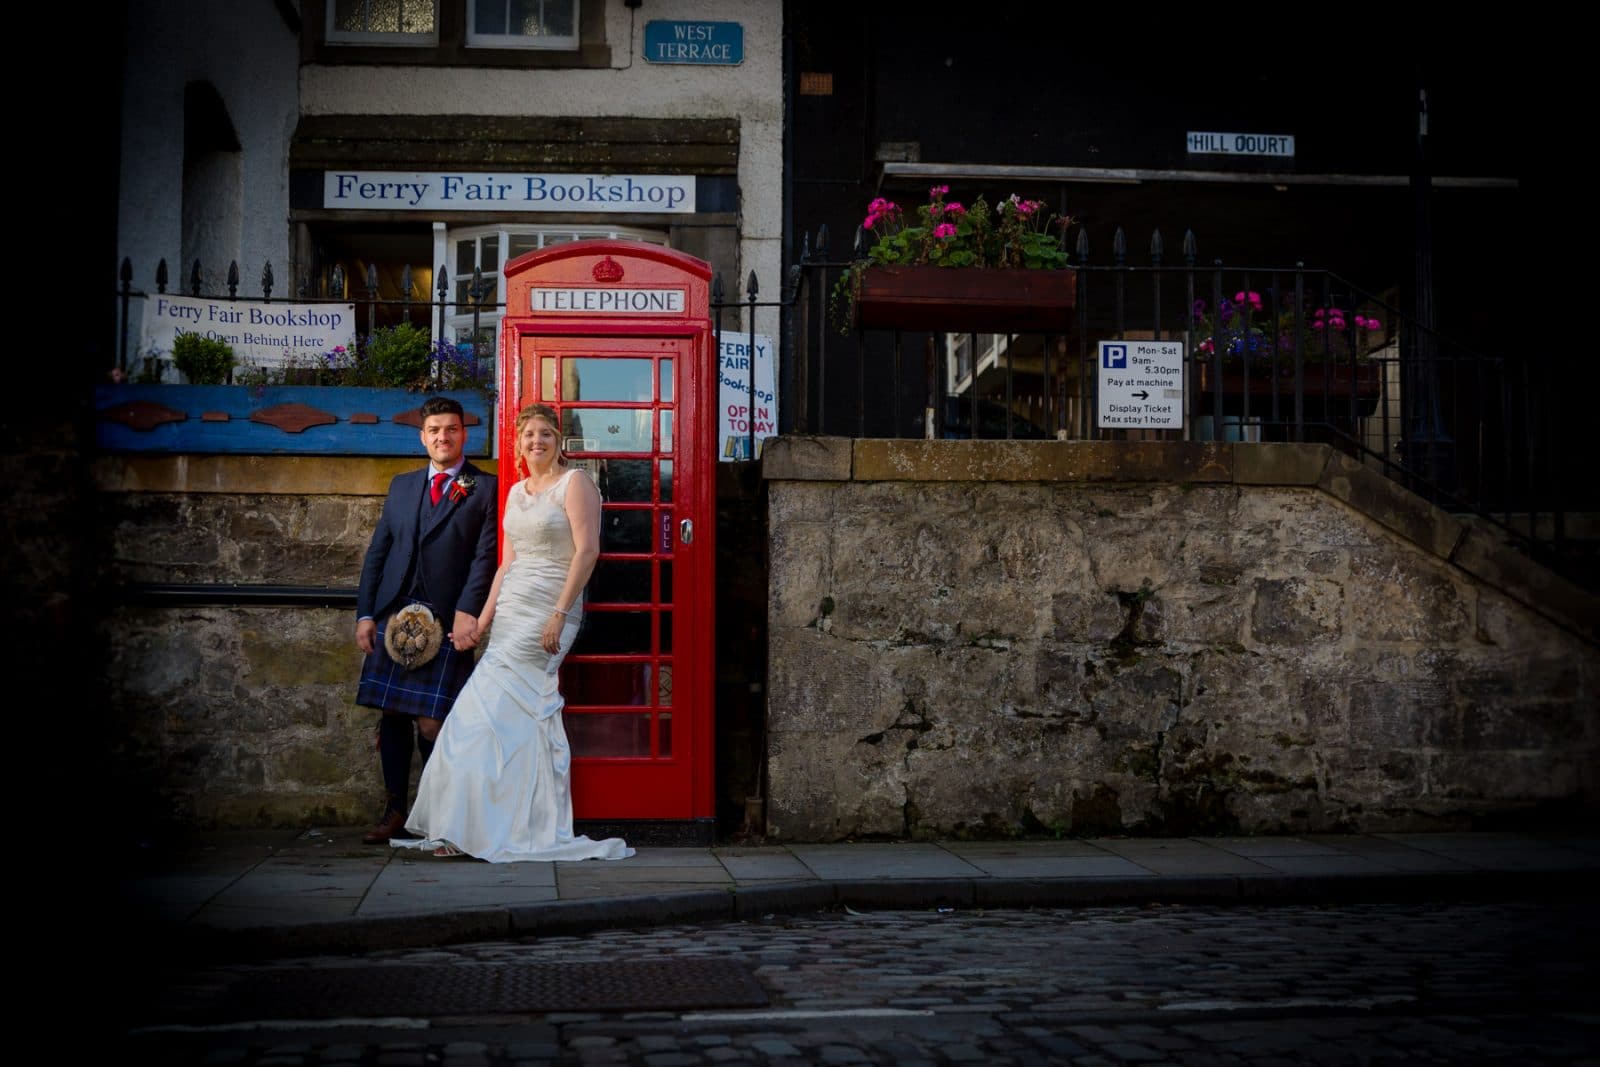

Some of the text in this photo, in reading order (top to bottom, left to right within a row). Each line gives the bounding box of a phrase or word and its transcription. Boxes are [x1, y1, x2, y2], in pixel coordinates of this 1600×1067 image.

[674, 25, 715, 40] WEST
[657, 43, 731, 59] TERRACE
[1193, 134, 1230, 152] HILL
[334, 174, 686, 209] Ferry Fair Bookshop
[538, 291, 678, 311] TELEPHONE
[157, 299, 342, 329] Ferry Fair Bookshop
[244, 332, 288, 347] Behind
[293, 335, 324, 347] Here
[1108, 347, 1124, 367] P
[1145, 366, 1180, 375] 5.30pm
[1107, 378, 1123, 387] Pay
[1136, 378, 1174, 387] machine
[727, 405, 768, 420] OPN
[1109, 404, 1171, 414] Display Ticket
[1103, 415, 1122, 424] Max
[1123, 416, 1142, 425] stay
[1150, 416, 1171, 424] hour
